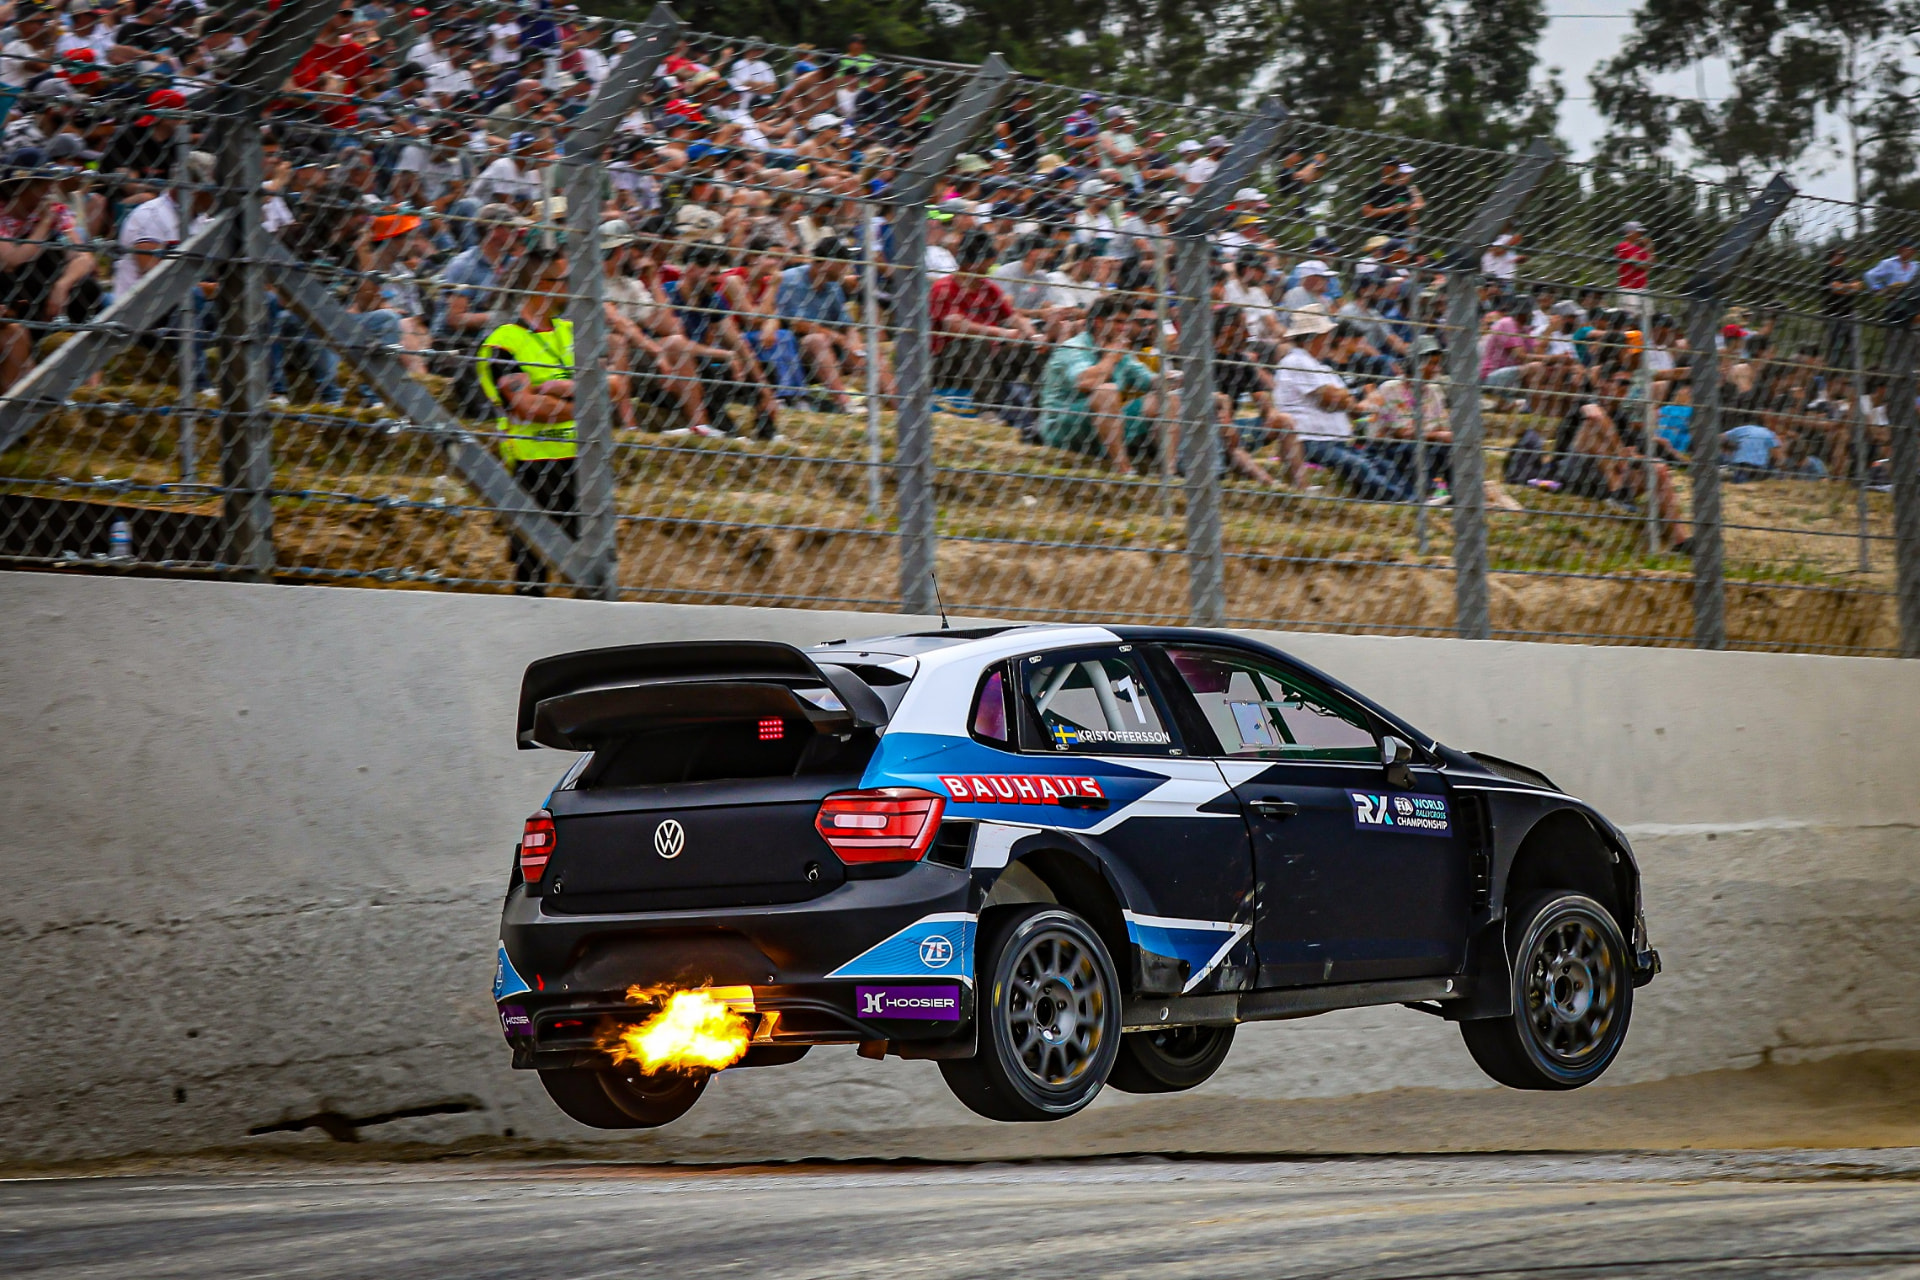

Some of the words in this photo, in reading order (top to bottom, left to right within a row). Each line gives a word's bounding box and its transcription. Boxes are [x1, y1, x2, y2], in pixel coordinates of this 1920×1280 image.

[1117, 675, 1147, 724] 1
[1077, 730, 1171, 743] KRISTOFFERSSON
[1352, 793, 1394, 825] RX
[1395, 799, 1413, 813] FIA
[1412, 798, 1445, 811] WORLD
[1416, 809, 1446, 820] RALLYCROSS
[1397, 817, 1448, 830] CHAMPIONSHIP
[921, 940, 952, 963] ZF
[886, 998, 955, 1008] HOOSIER
